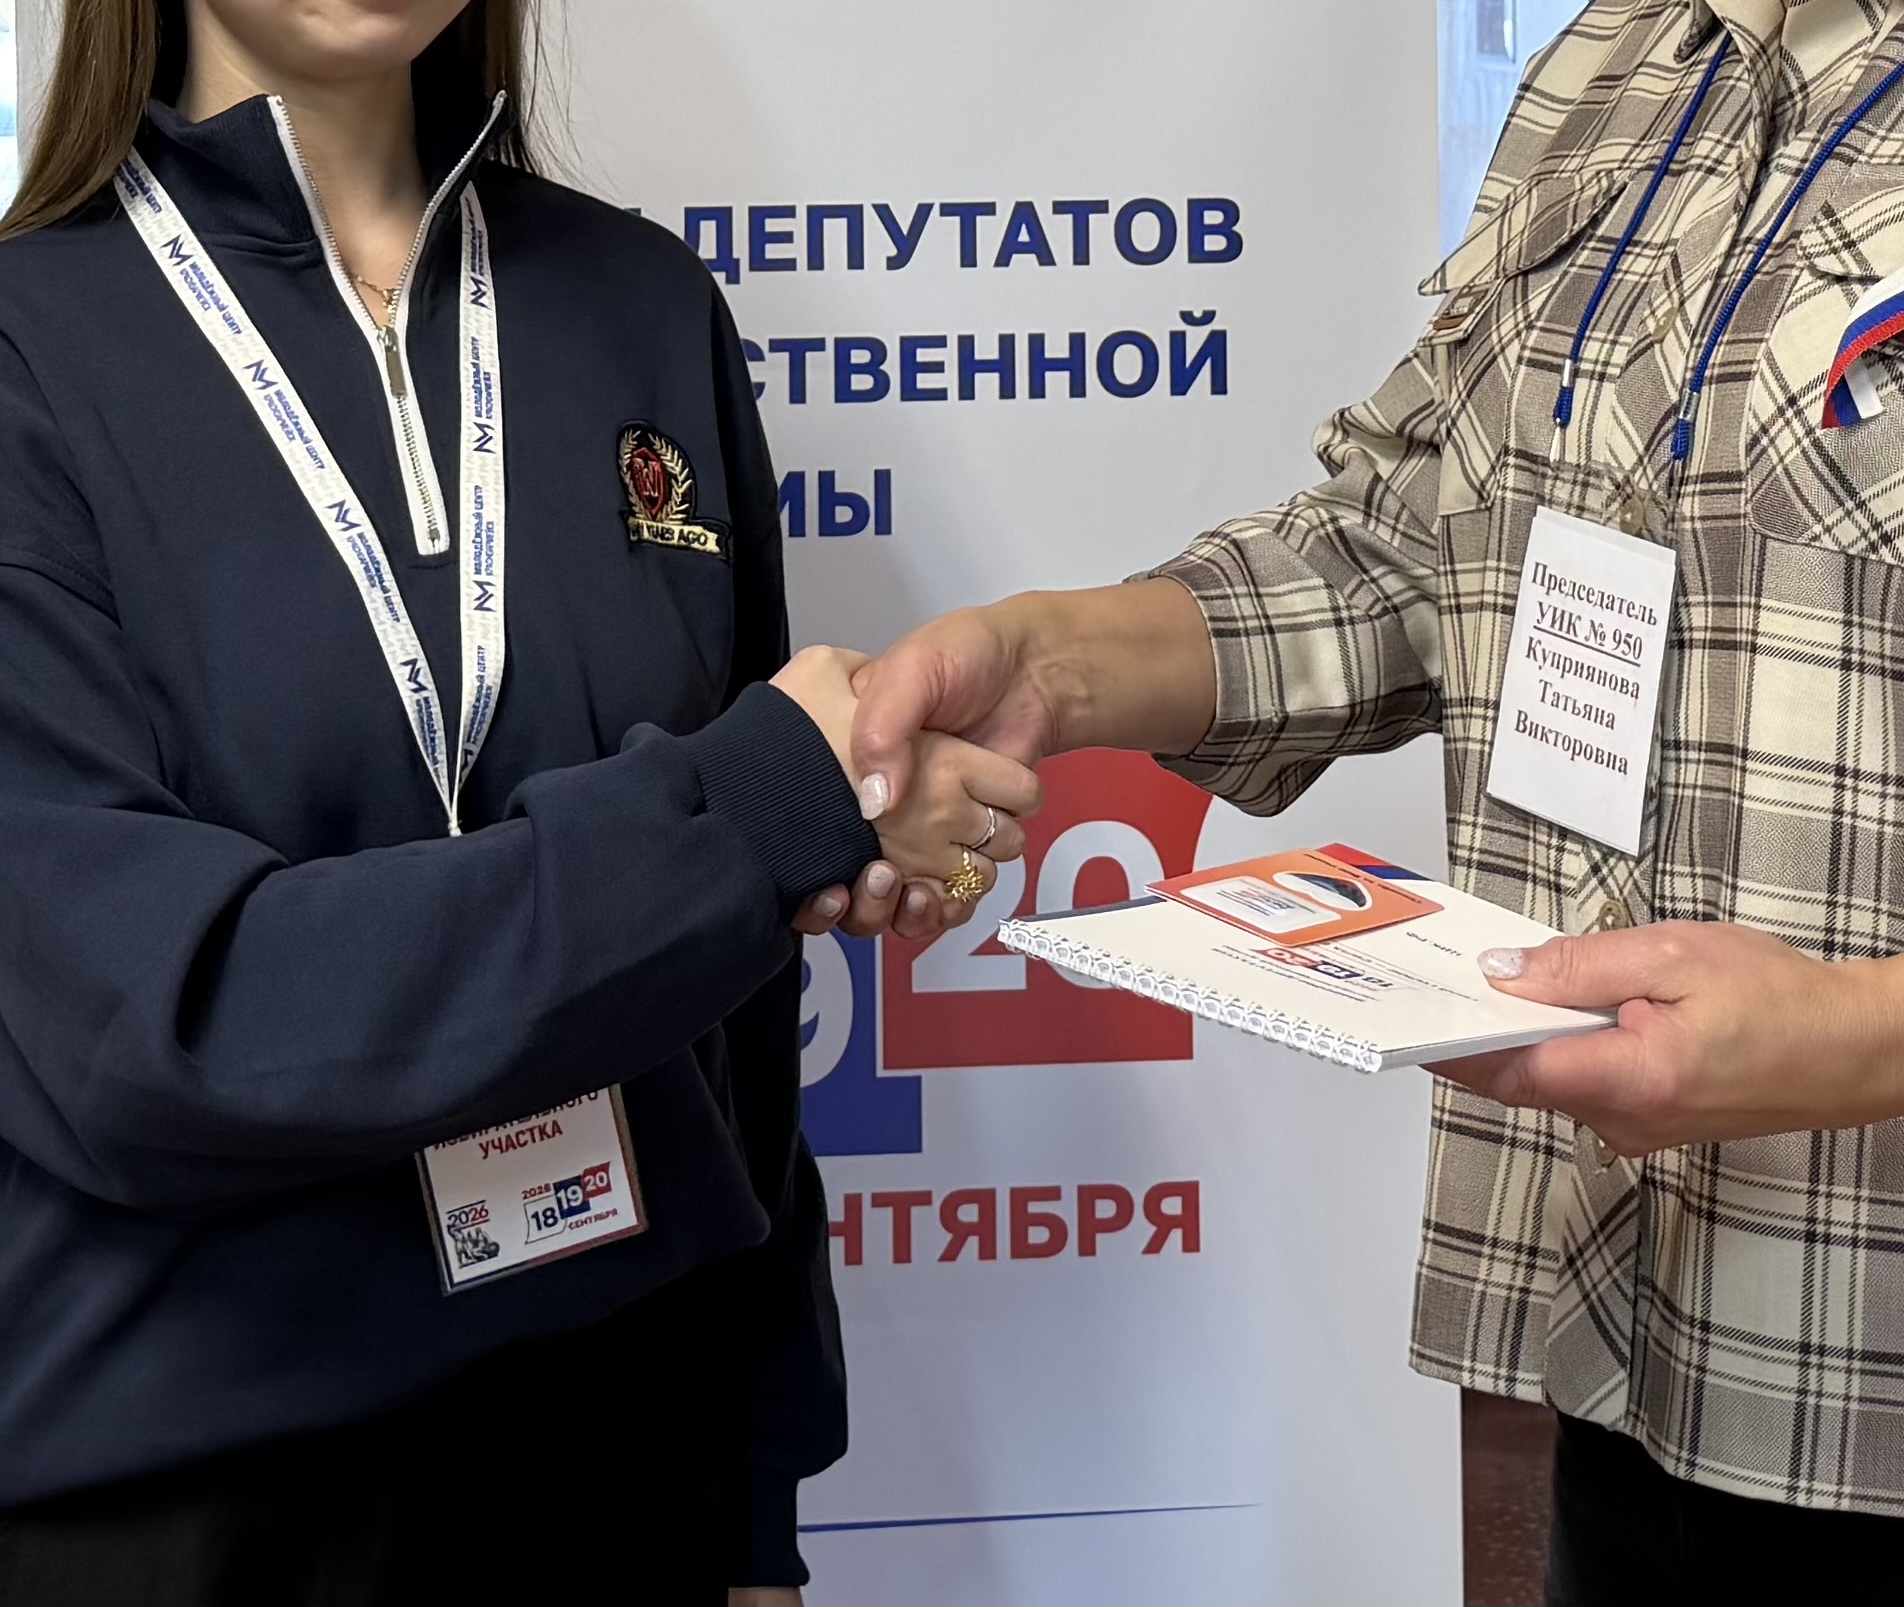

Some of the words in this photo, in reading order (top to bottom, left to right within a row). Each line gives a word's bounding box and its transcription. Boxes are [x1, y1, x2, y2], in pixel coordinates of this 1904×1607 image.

[684, 197, 1244, 285] ДЕПУТАТОВ
[1531, 562, 1657, 626] Председатель
[1536, 601, 1582, 638] УИК
[1585, 621, 1606, 645] №
[1613, 628, 1643, 661] 950
[1525, 636, 1640, 700] Куприянова
[1539, 680, 1616, 730] Татьяна
[1514, 709, 1628, 776] Викторовна
[479, 1119, 563, 1159] УЧАСТКА
[557, 1185, 583, 1210] 19
[583, 1170, 608, 1192] 20
[448, 1204, 489, 1227] 2026
[530, 1207, 558, 1231] 18
[567, 1208, 618, 1231] СЕНТЯБРЯ
[828, 1180, 1202, 1267] НТЯБРЯ
